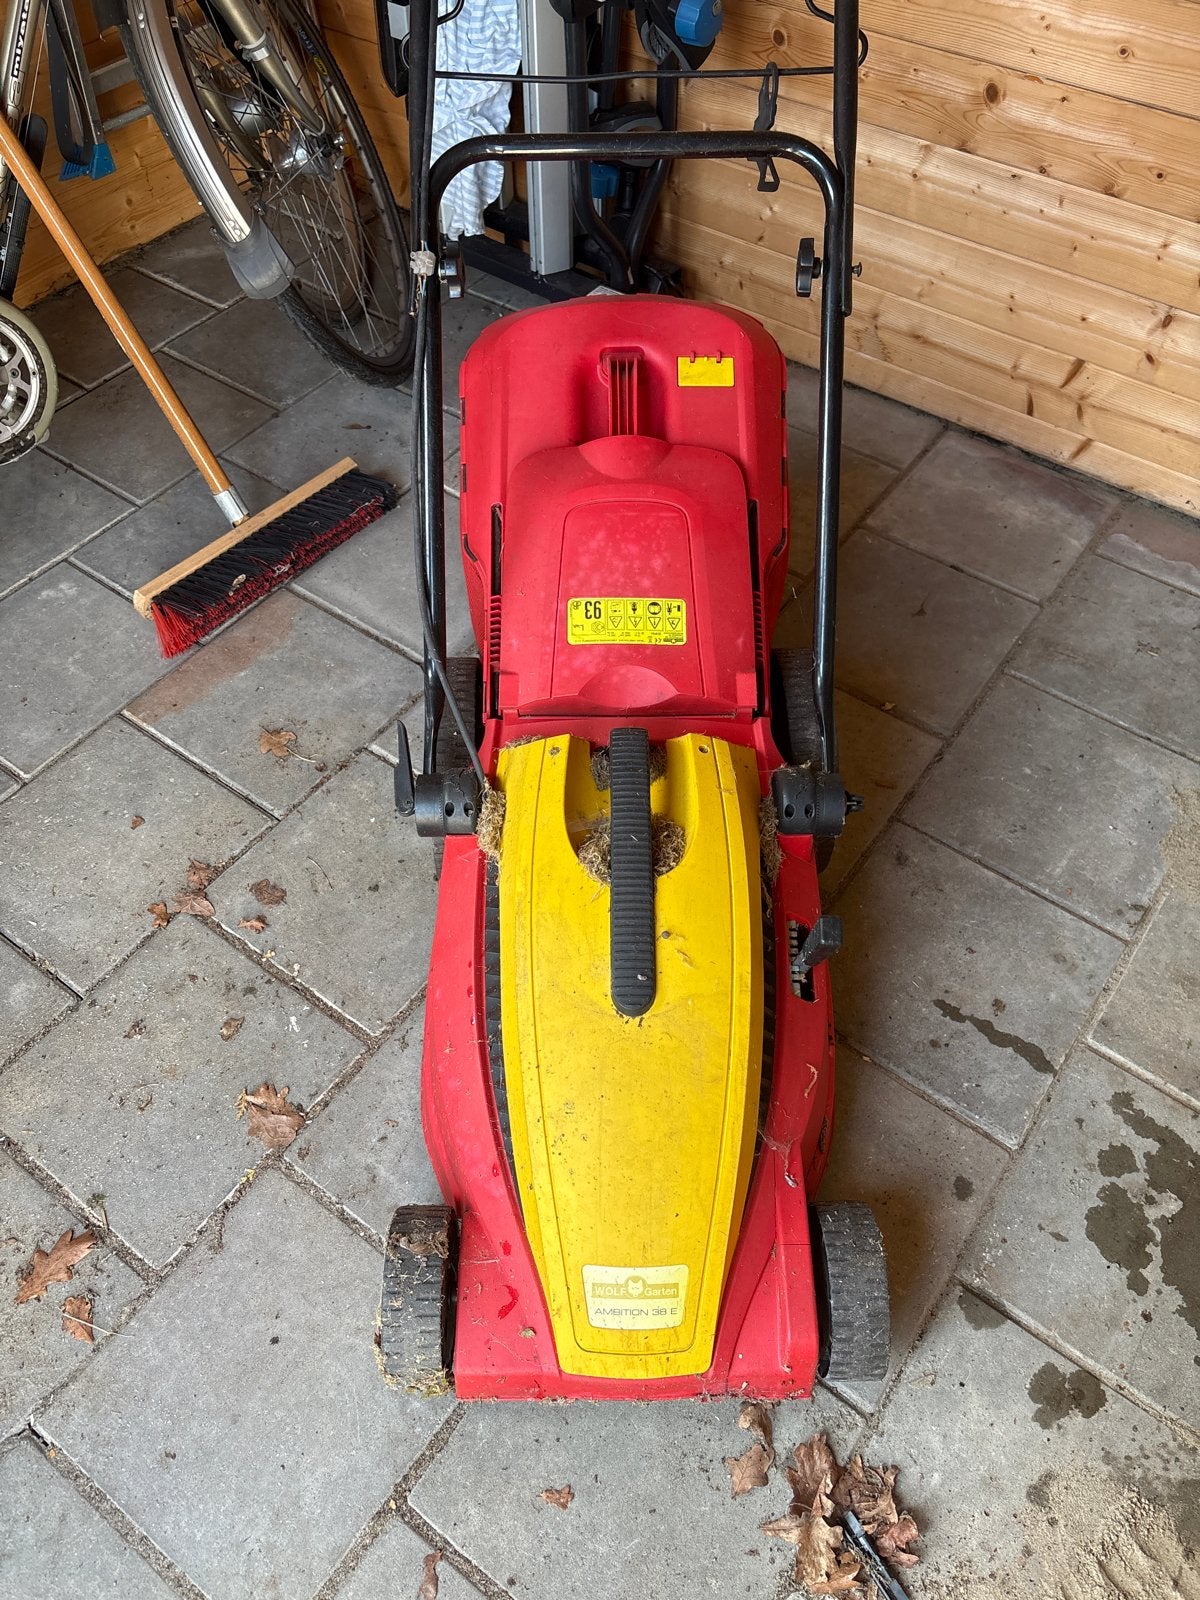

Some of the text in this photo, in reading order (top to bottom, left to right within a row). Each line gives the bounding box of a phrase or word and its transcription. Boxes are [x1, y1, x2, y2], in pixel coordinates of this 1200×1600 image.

[585, 601, 601, 619] 93
[594, 1286, 678, 1297] WOLF Garten
[594, 1307, 679, 1316] AMBITION 38 E
